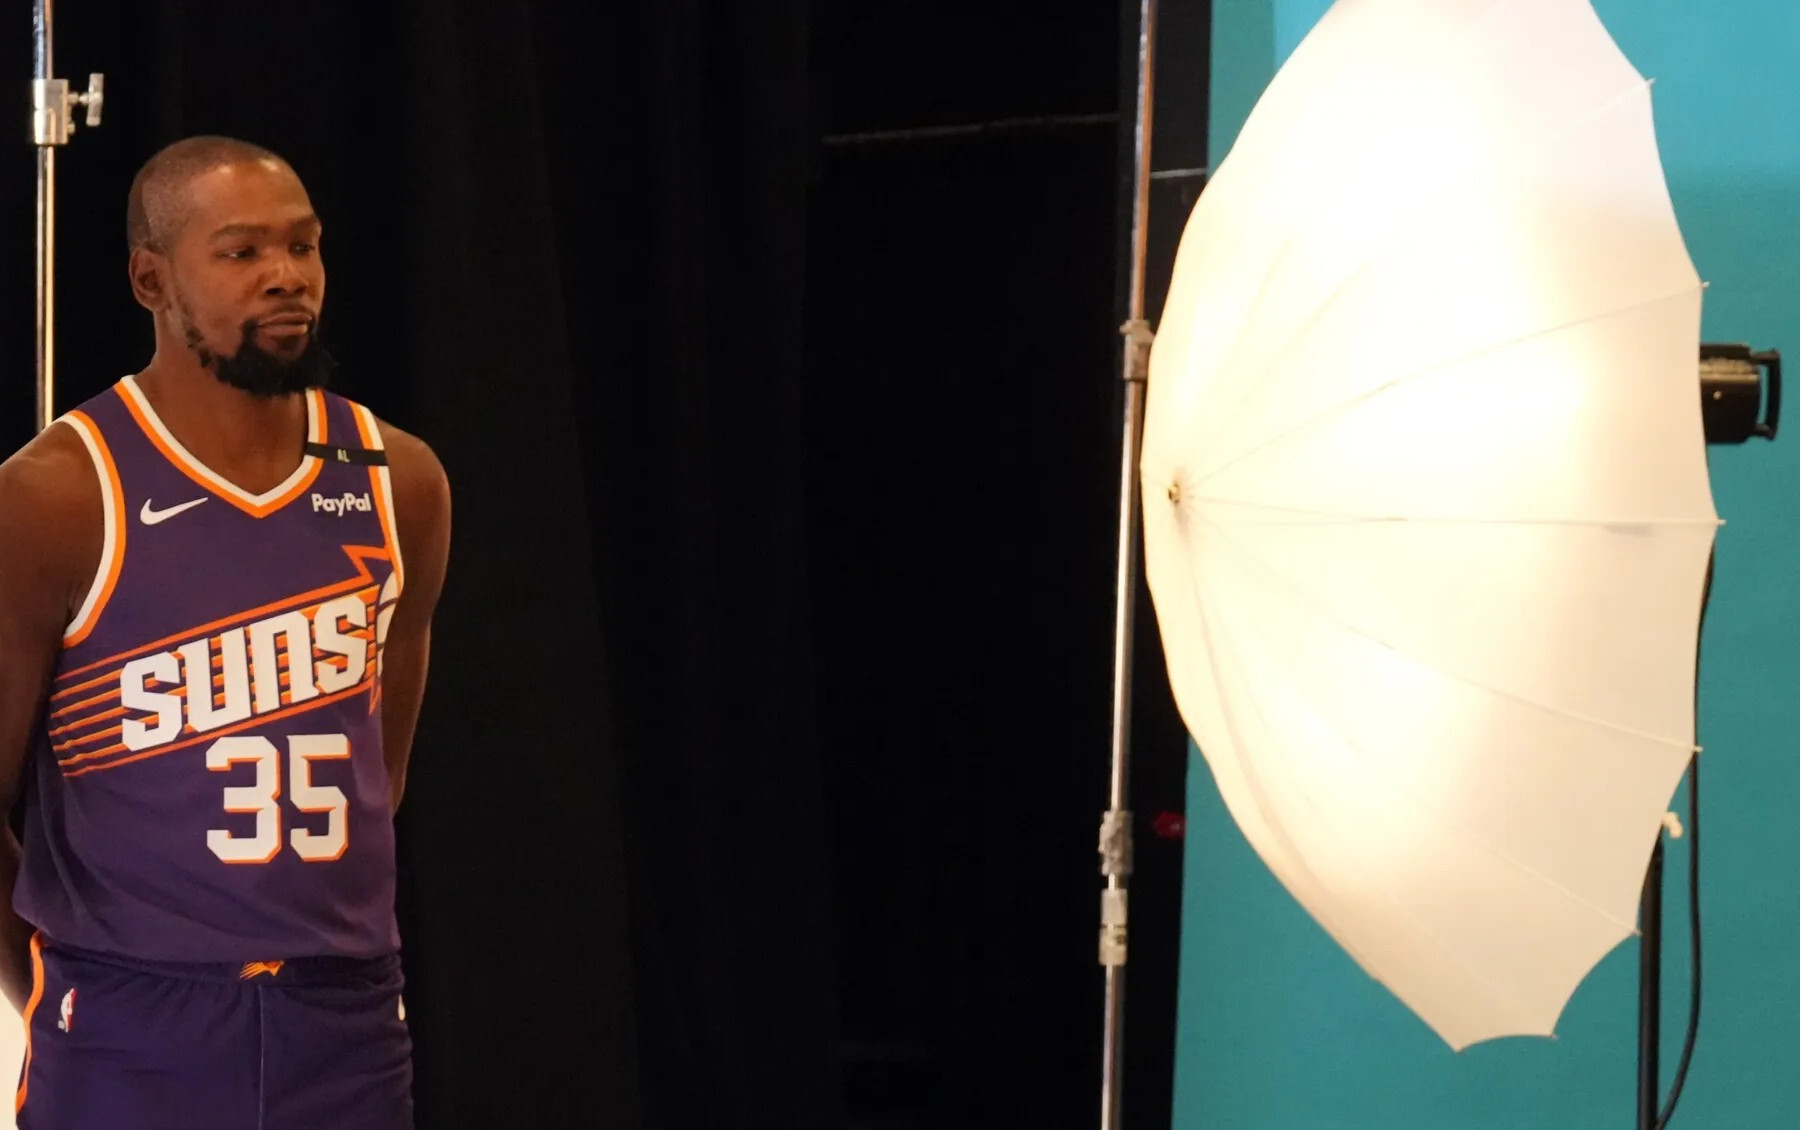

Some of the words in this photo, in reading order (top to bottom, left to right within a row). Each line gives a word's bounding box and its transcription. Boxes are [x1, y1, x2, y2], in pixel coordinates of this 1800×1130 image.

[337, 448, 350, 463] AL
[311, 492, 372, 517] PayPal
[206, 733, 351, 864] 35
